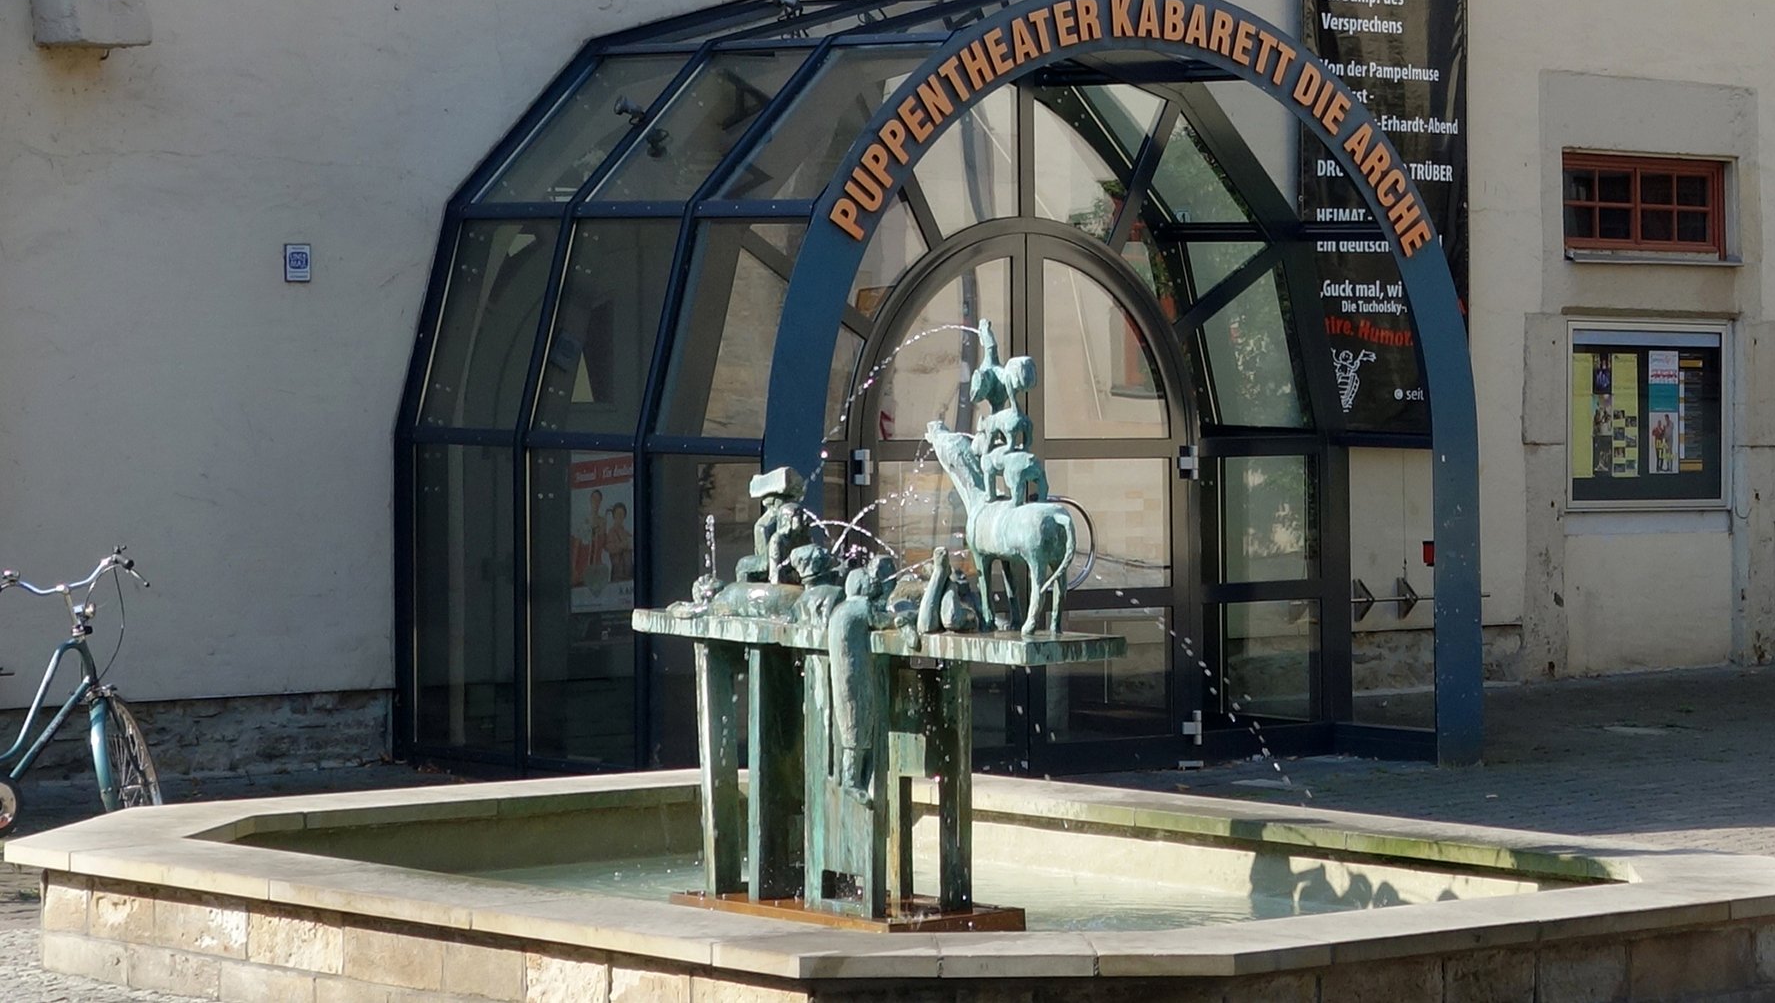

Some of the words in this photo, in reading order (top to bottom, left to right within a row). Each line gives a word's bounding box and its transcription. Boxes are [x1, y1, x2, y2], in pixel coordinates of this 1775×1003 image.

[1321, 12, 1403, 36] Versprechens
[1346, 60, 1367, 78] der
[1369, 61, 1440, 83] Pampelmuse
[1374, 114, 1459, 135] -Erhardt-Abend
[1292, 64, 1352, 137] DIE
[1343, 122, 1432, 258] ARCHE
[1409, 160, 1453, 182] TRÜBER
[1316, 208, 1366, 222] HEIMAT
[1338, 240, 1392, 253] deutsch
[1355, 279, 1384, 300] mal,
[1386, 281, 1403, 298] wi
[1341, 300, 1357, 313] Die
